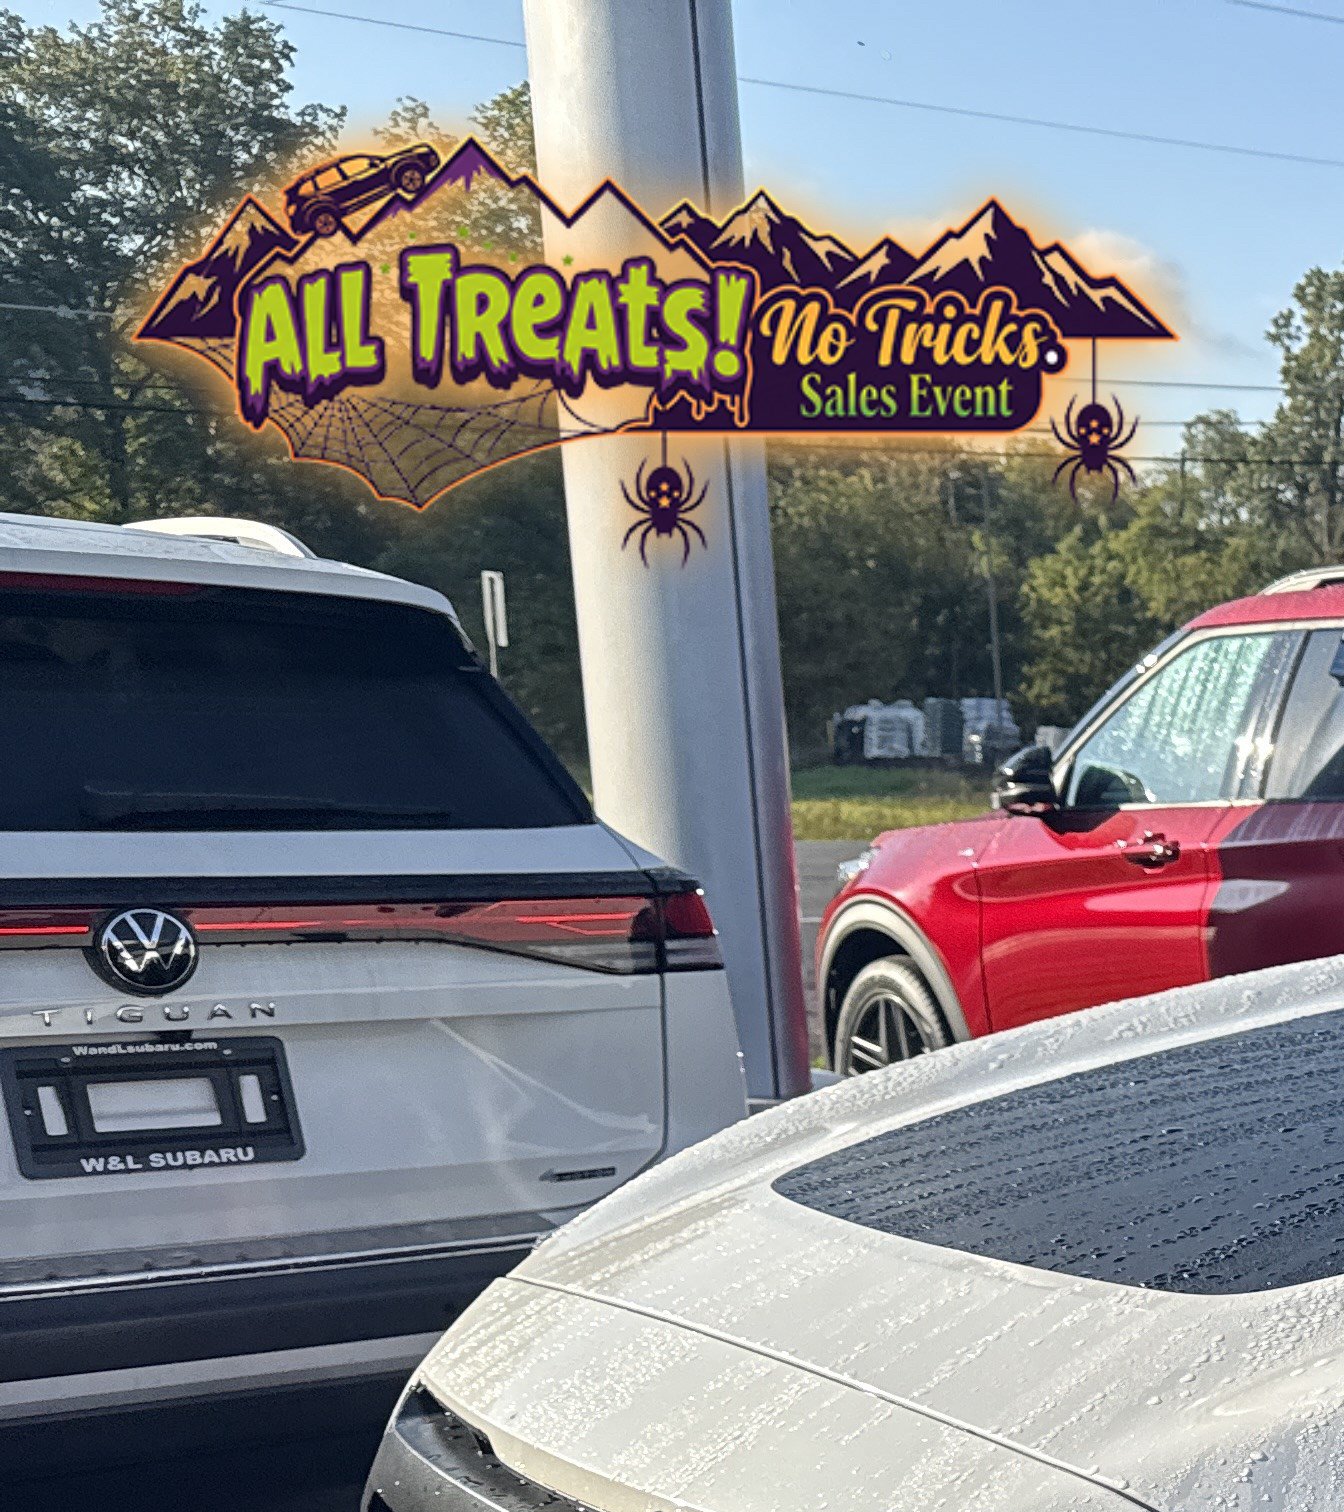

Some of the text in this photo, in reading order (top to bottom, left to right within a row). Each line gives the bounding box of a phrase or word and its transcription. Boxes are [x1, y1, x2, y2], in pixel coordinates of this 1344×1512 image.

[33, 1002, 277, 1027] TIGUAN
[80, 1147, 256, 1173] W&L SUBARU
